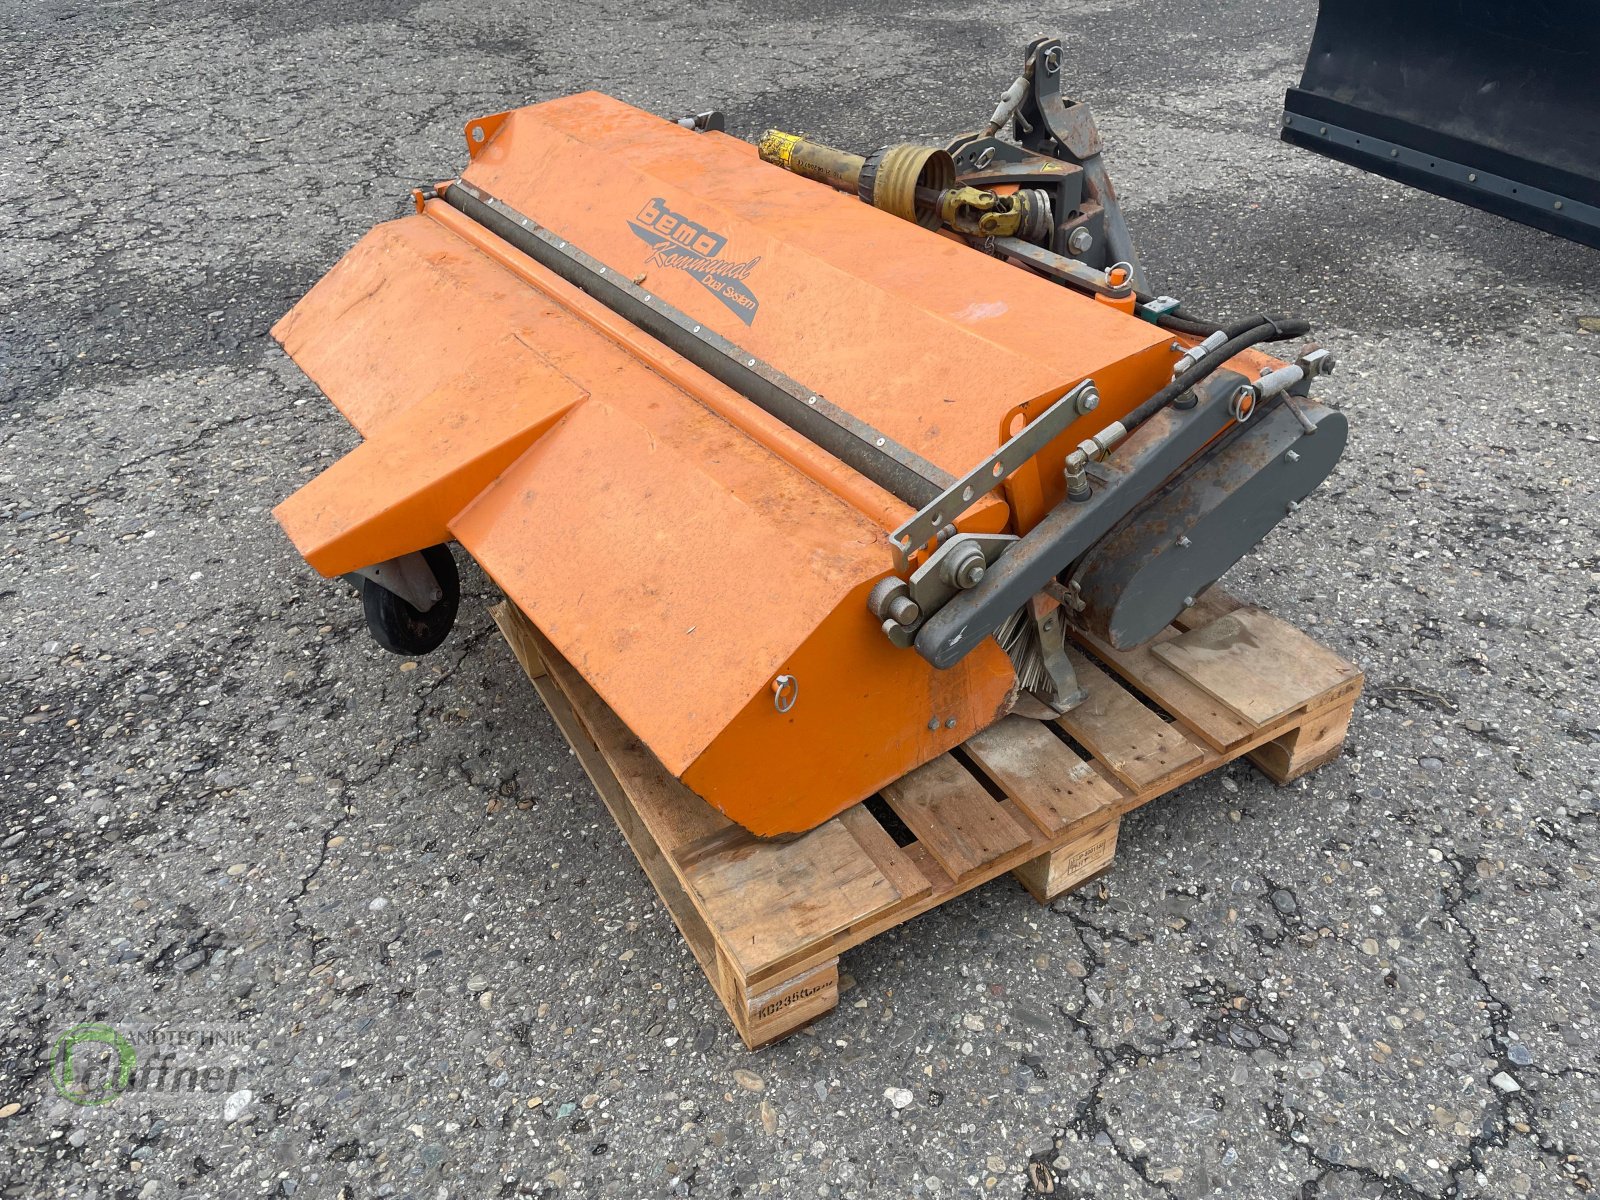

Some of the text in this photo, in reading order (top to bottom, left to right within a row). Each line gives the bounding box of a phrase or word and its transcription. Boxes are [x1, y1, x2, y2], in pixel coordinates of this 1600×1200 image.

[636, 198, 723, 257] bema
[644, 241, 762, 281] Kommunal
[701, 274, 757, 310] Dual System
